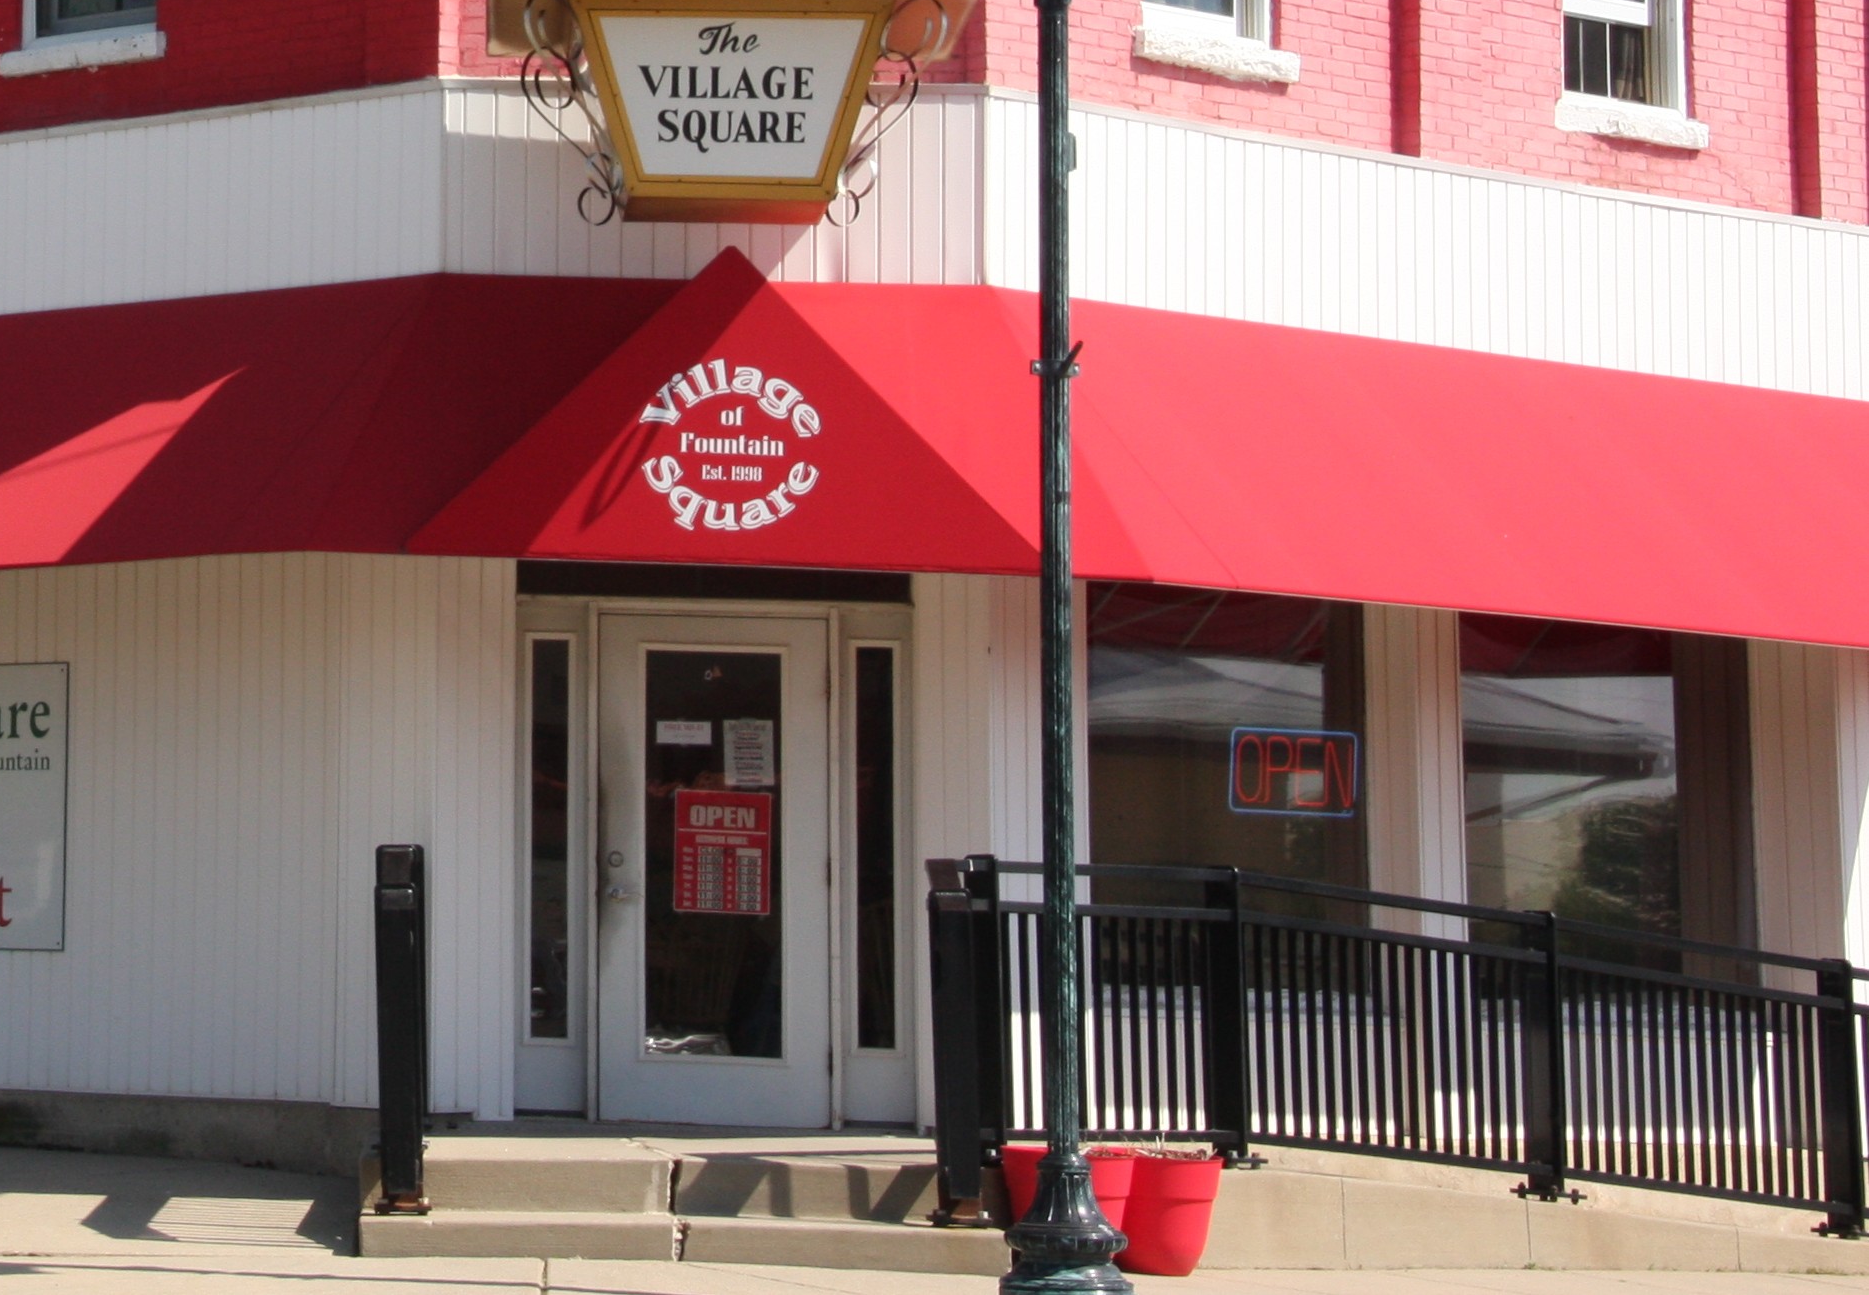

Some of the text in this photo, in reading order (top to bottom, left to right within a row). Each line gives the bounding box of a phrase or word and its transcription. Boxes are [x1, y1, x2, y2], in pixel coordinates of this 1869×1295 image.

[698, 21, 760, 55] The
[638, 64, 814, 100] VILLAGE
[657, 109, 806, 153] SQUARE
[639, 358, 821, 438] Village
[720, 405, 745, 426] of
[680, 432, 784, 456] Fountain
[701, 464, 727, 481] Est.
[641, 455, 820, 531] Square
[1235, 734, 1353, 809] OPEN
[689, 805, 756, 829] OPEN
